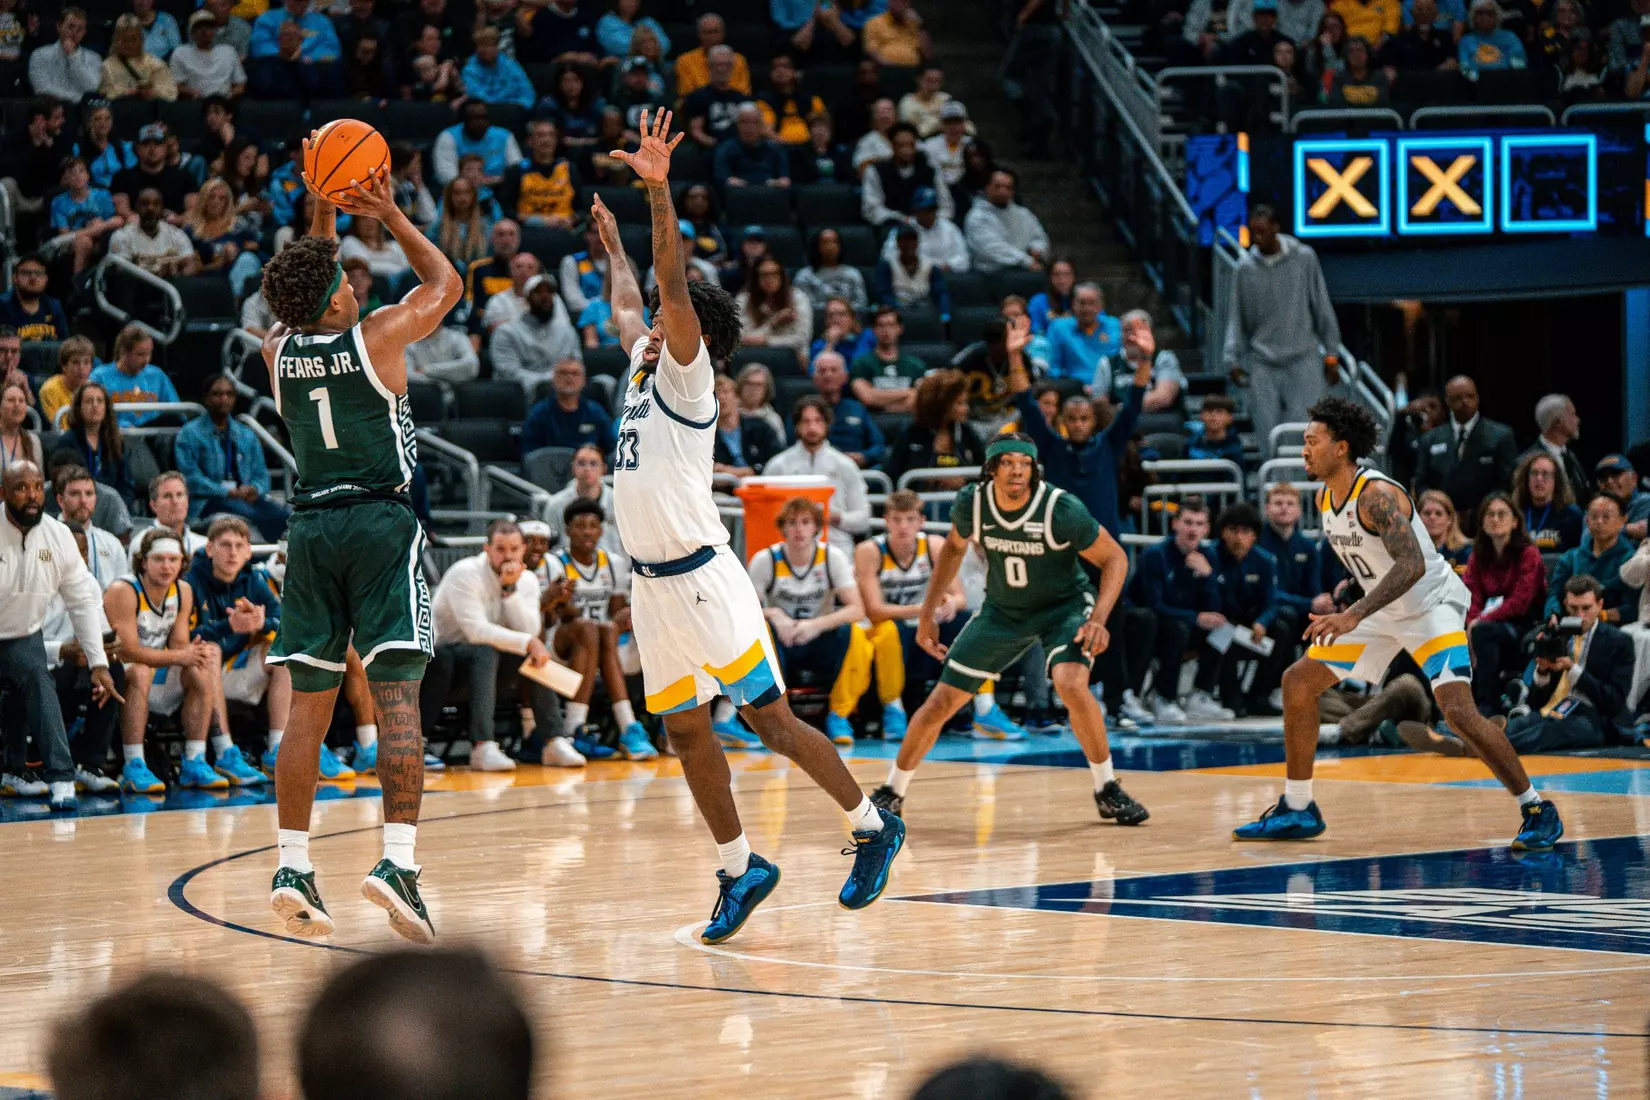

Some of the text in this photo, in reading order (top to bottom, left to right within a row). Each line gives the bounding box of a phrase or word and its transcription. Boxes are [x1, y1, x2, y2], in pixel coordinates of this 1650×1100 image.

[279, 351, 361, 379] FEARS JR.
[308, 386, 339, 450] 1
[614, 428, 640, 471] 33
[983, 535, 1045, 556] SPARTANS
[1004, 556, 1028, 588] 0
